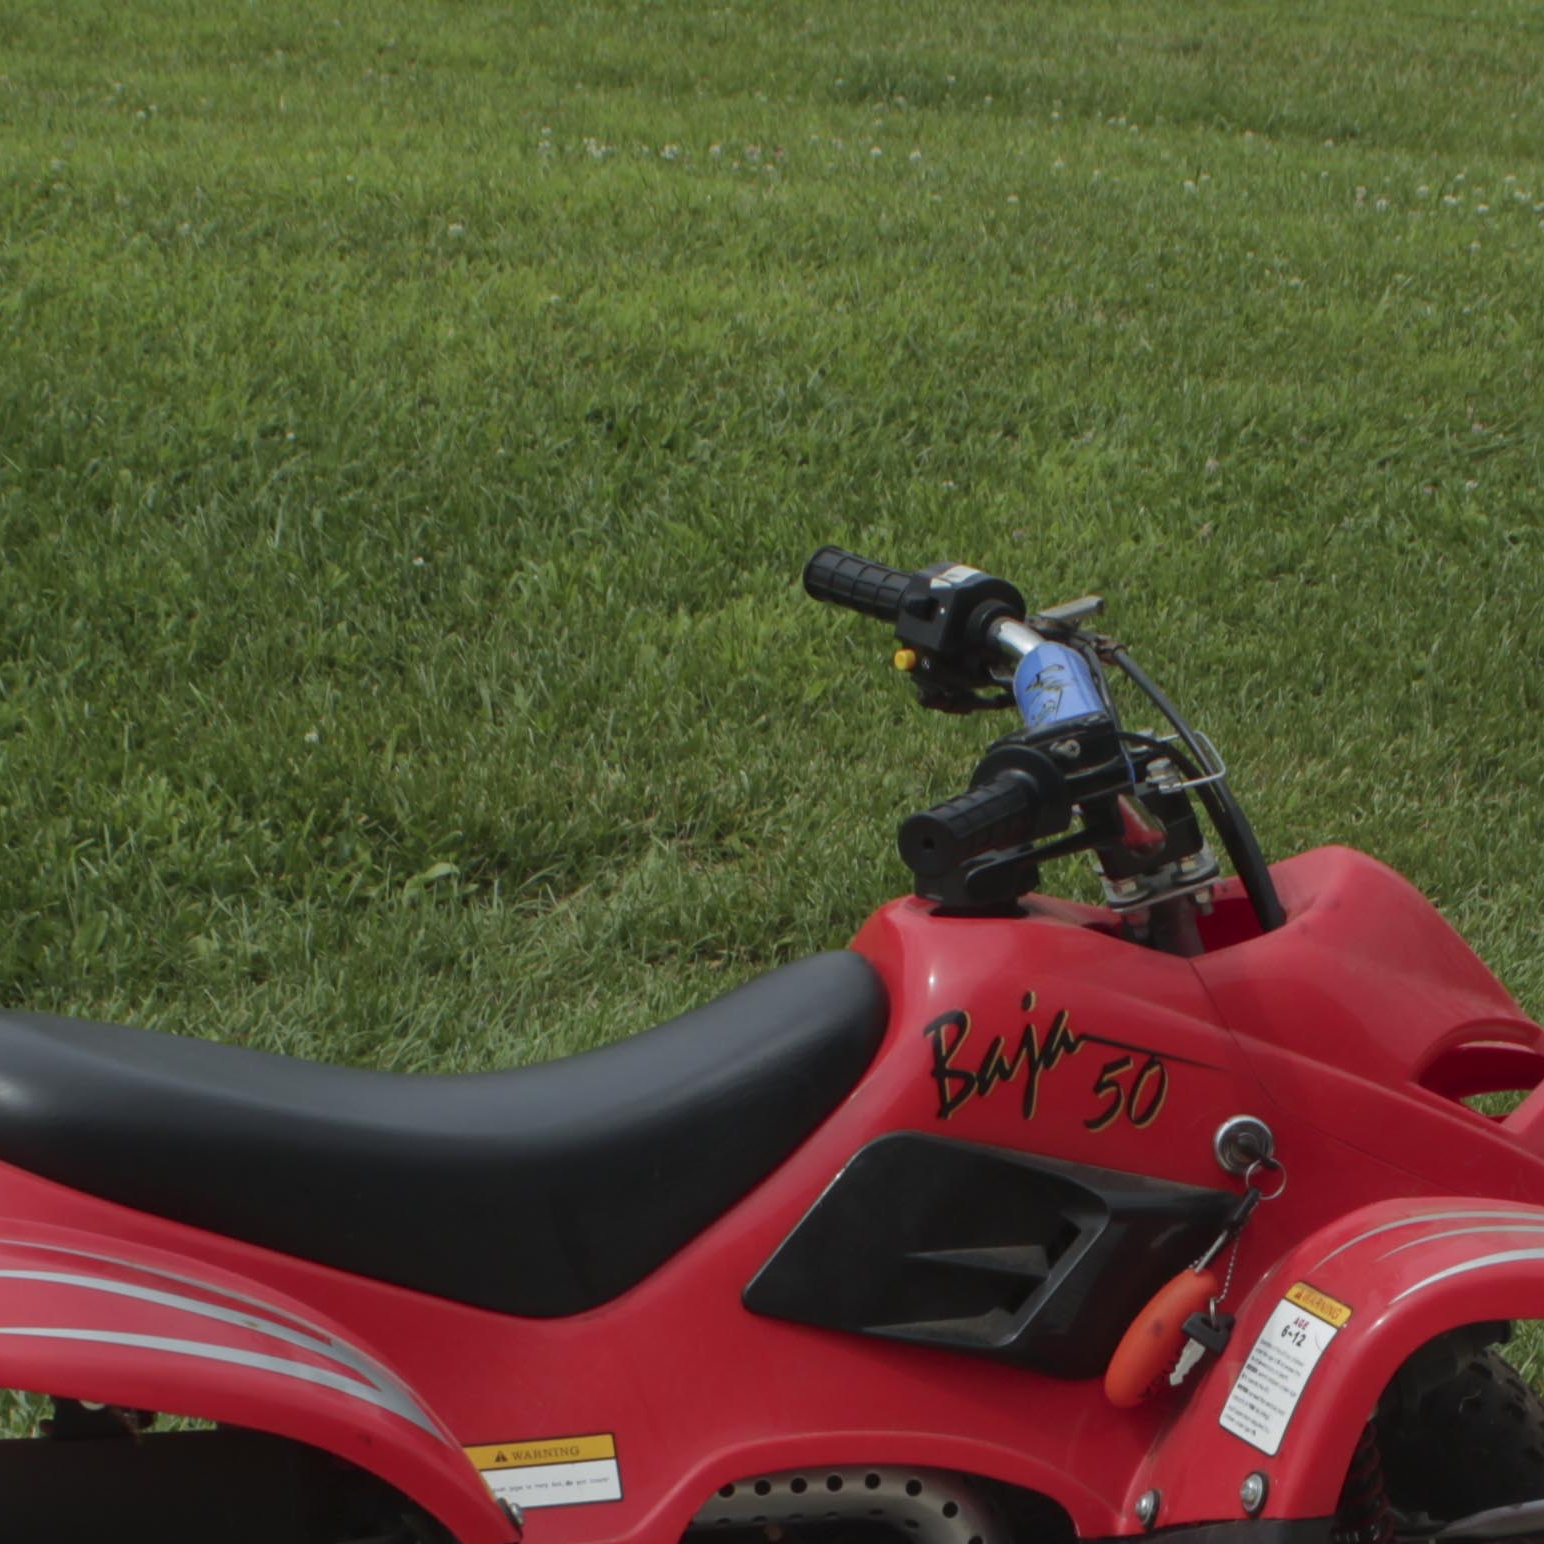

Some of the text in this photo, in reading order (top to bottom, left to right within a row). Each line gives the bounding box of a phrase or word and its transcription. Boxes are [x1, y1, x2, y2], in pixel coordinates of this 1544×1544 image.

[923, 990, 1229, 1121] Baja
[1083, 1055, 1169, 1133] 50
[1293, 1317, 1310, 1331] AGE
[1280, 1325, 1307, 1347] 6-12
[512, 1446, 580, 1461] WARNING
